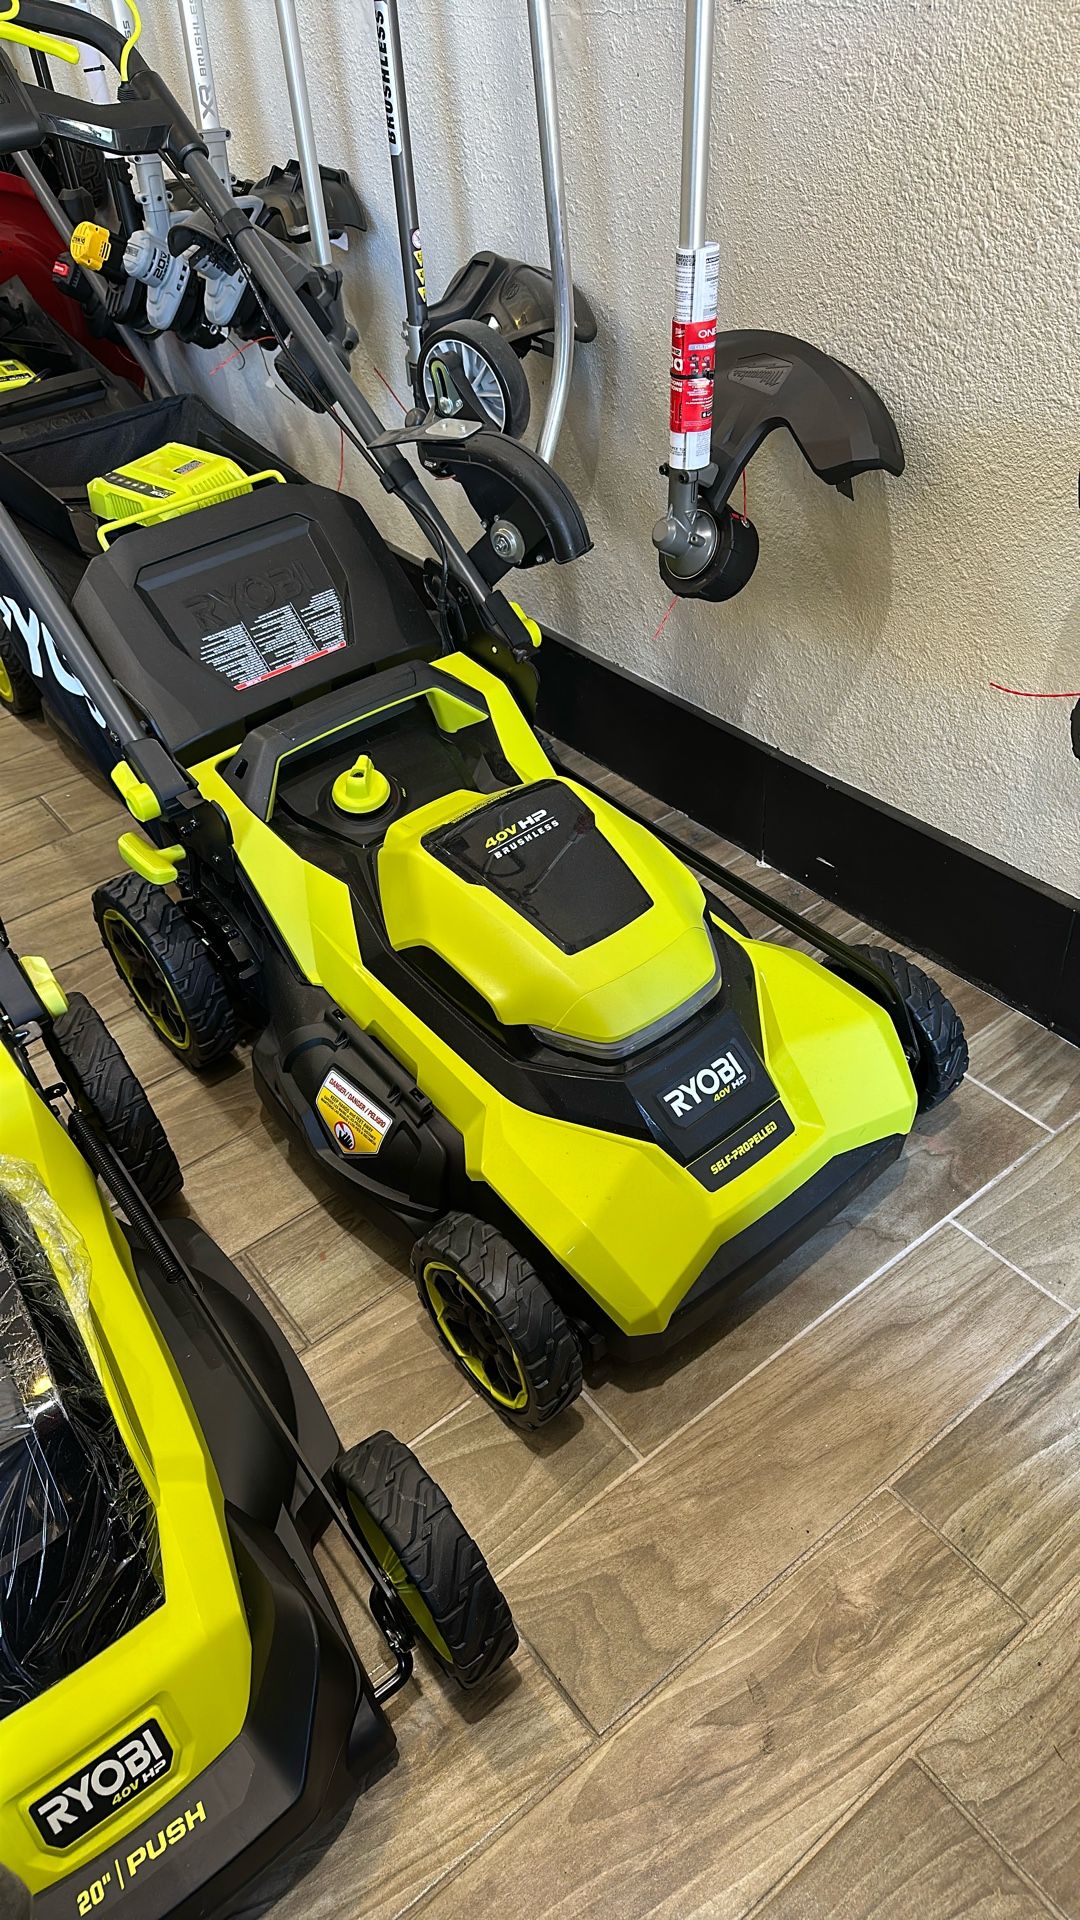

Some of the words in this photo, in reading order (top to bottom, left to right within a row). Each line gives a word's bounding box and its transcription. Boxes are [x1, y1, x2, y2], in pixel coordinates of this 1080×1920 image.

[374, 9, 397, 145] BRUSHLESS
[183, 559, 315, 631] RYOBI
[485, 823, 518, 849] 40V
[517, 809, 547, 830] HP
[493, 819, 560, 859] BRUSHLESS
[663, 1052, 744, 1118] RYOBI
[713, 1086, 731, 1102] 40V
[731, 1074, 747, 1089] HP
[367, 1110, 386, 1128] PELIGRO
[710, 1121, 778, 1175] SELF-PROPELLED
[37, 1728, 163, 1835] RYOBI
[112, 1779, 139, 1806] 40V
[142, 1759, 167, 1783] HP
[76, 1872, 111, 1917] 20"
[126, 1801, 207, 1877] PUSH
